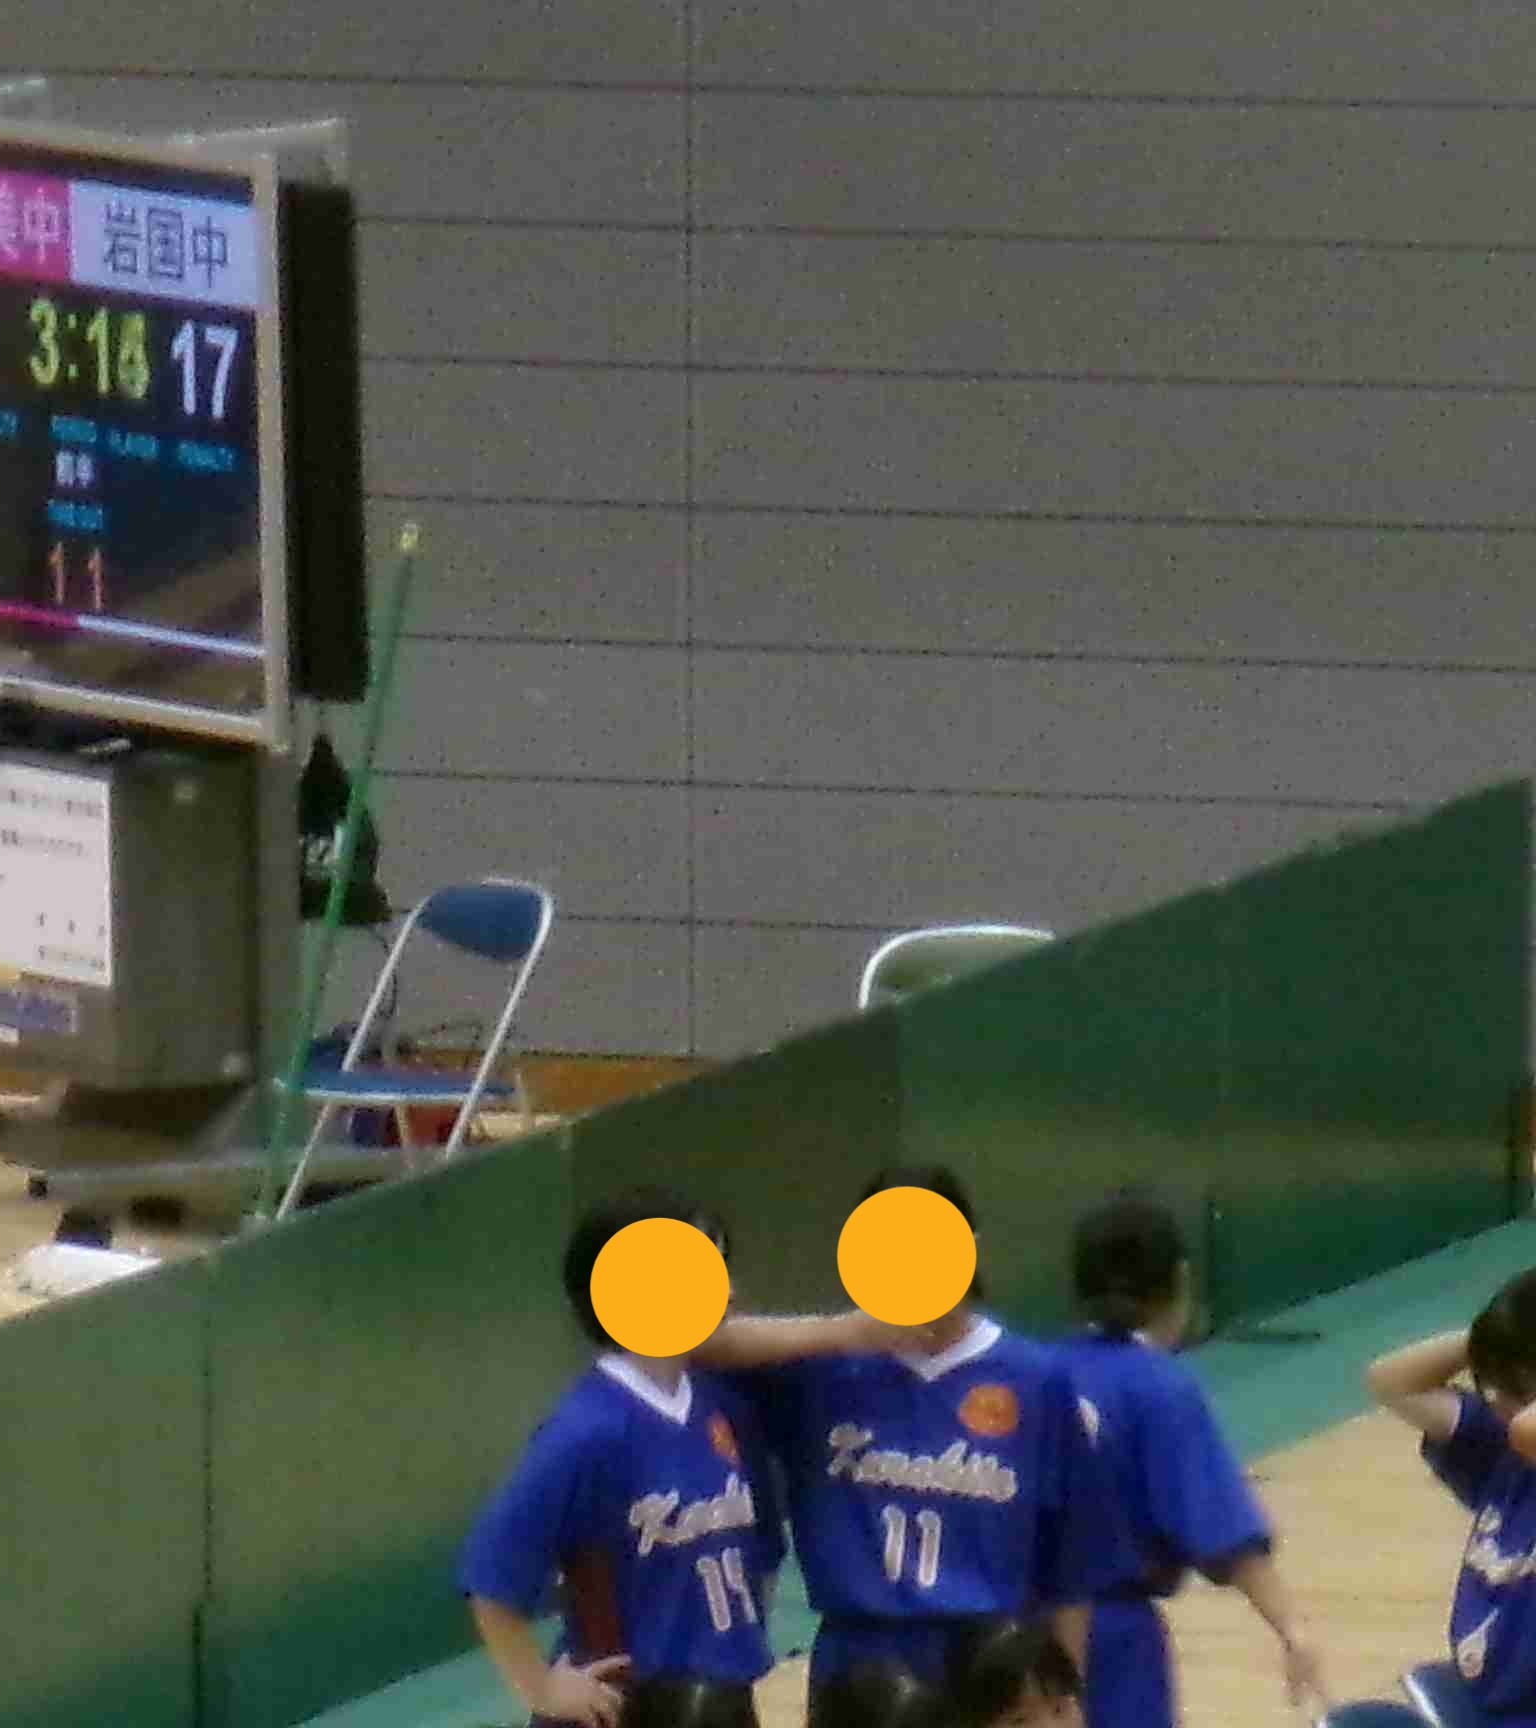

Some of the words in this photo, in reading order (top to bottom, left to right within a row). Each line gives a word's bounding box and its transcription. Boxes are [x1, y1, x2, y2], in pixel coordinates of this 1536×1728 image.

[104, 201, 229, 288] 岩国中
[170, 319, 239, 419] 17
[882, 1505, 942, 1587] 11
